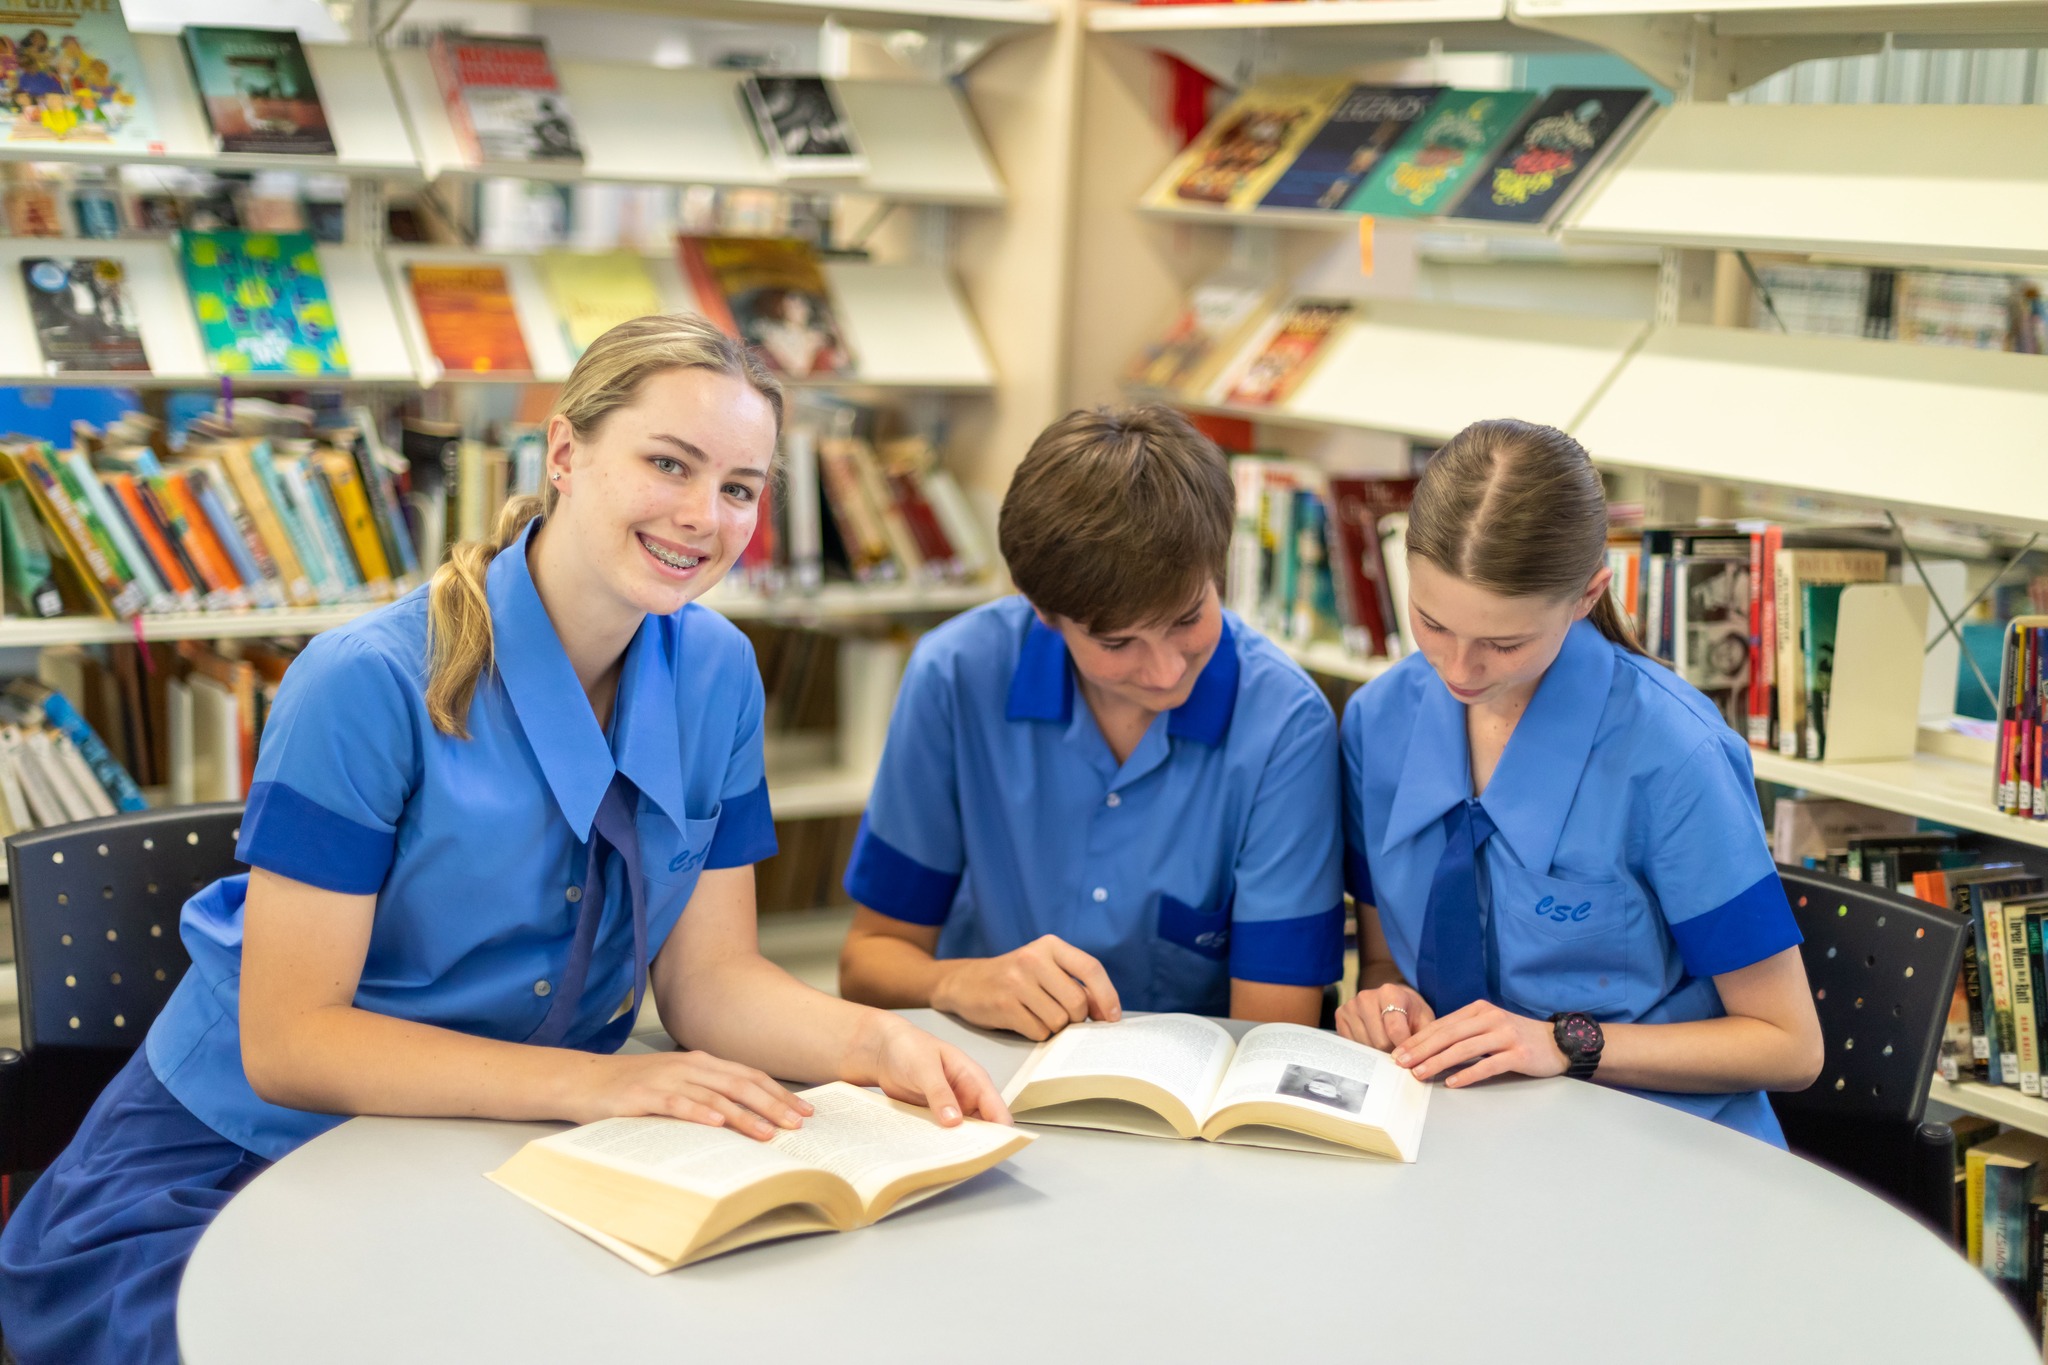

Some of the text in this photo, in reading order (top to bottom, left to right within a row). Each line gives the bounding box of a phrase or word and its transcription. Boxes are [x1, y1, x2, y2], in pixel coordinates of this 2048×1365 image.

[1988, 911, 2000, 948] LOST
[2010, 917, 2024, 944] Three
[1992, 952, 2004, 988] CITY
[2012, 947, 2027, 969] Men
[2015, 984, 2031, 1004] Raft
